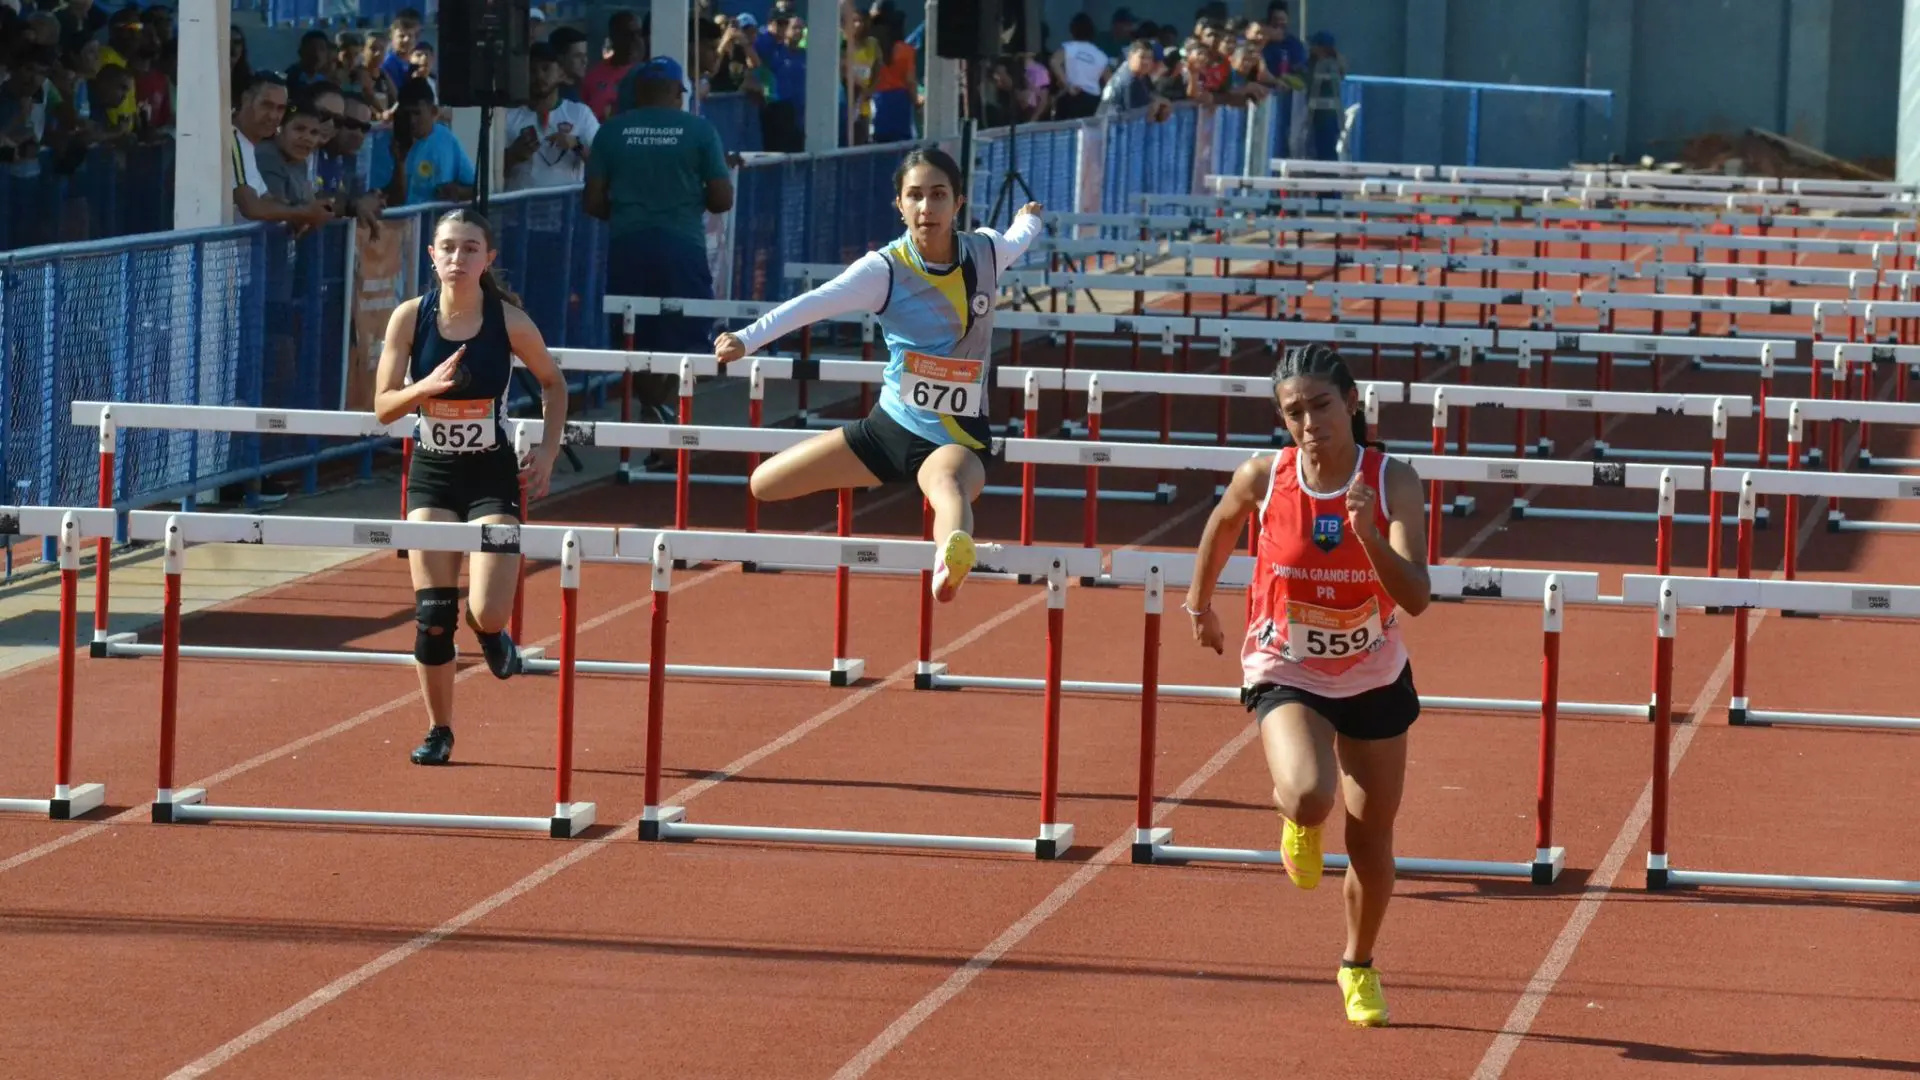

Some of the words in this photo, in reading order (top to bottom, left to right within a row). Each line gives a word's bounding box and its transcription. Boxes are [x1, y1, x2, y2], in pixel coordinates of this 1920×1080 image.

[622, 127, 683, 135] ARBITRAGEM
[626, 137, 678, 145] ATLETISMO
[913, 381, 968, 413] 670
[432, 423, 484, 448] 652
[1318, 519, 1339, 533] TB
[1272, 562, 1309, 580] CAMPINA
[1310, 569, 1350, 582] GRANDE
[1351, 571, 1366, 583] DO
[1316, 586, 1336, 600] PR
[1306, 627, 1369, 656] 559
